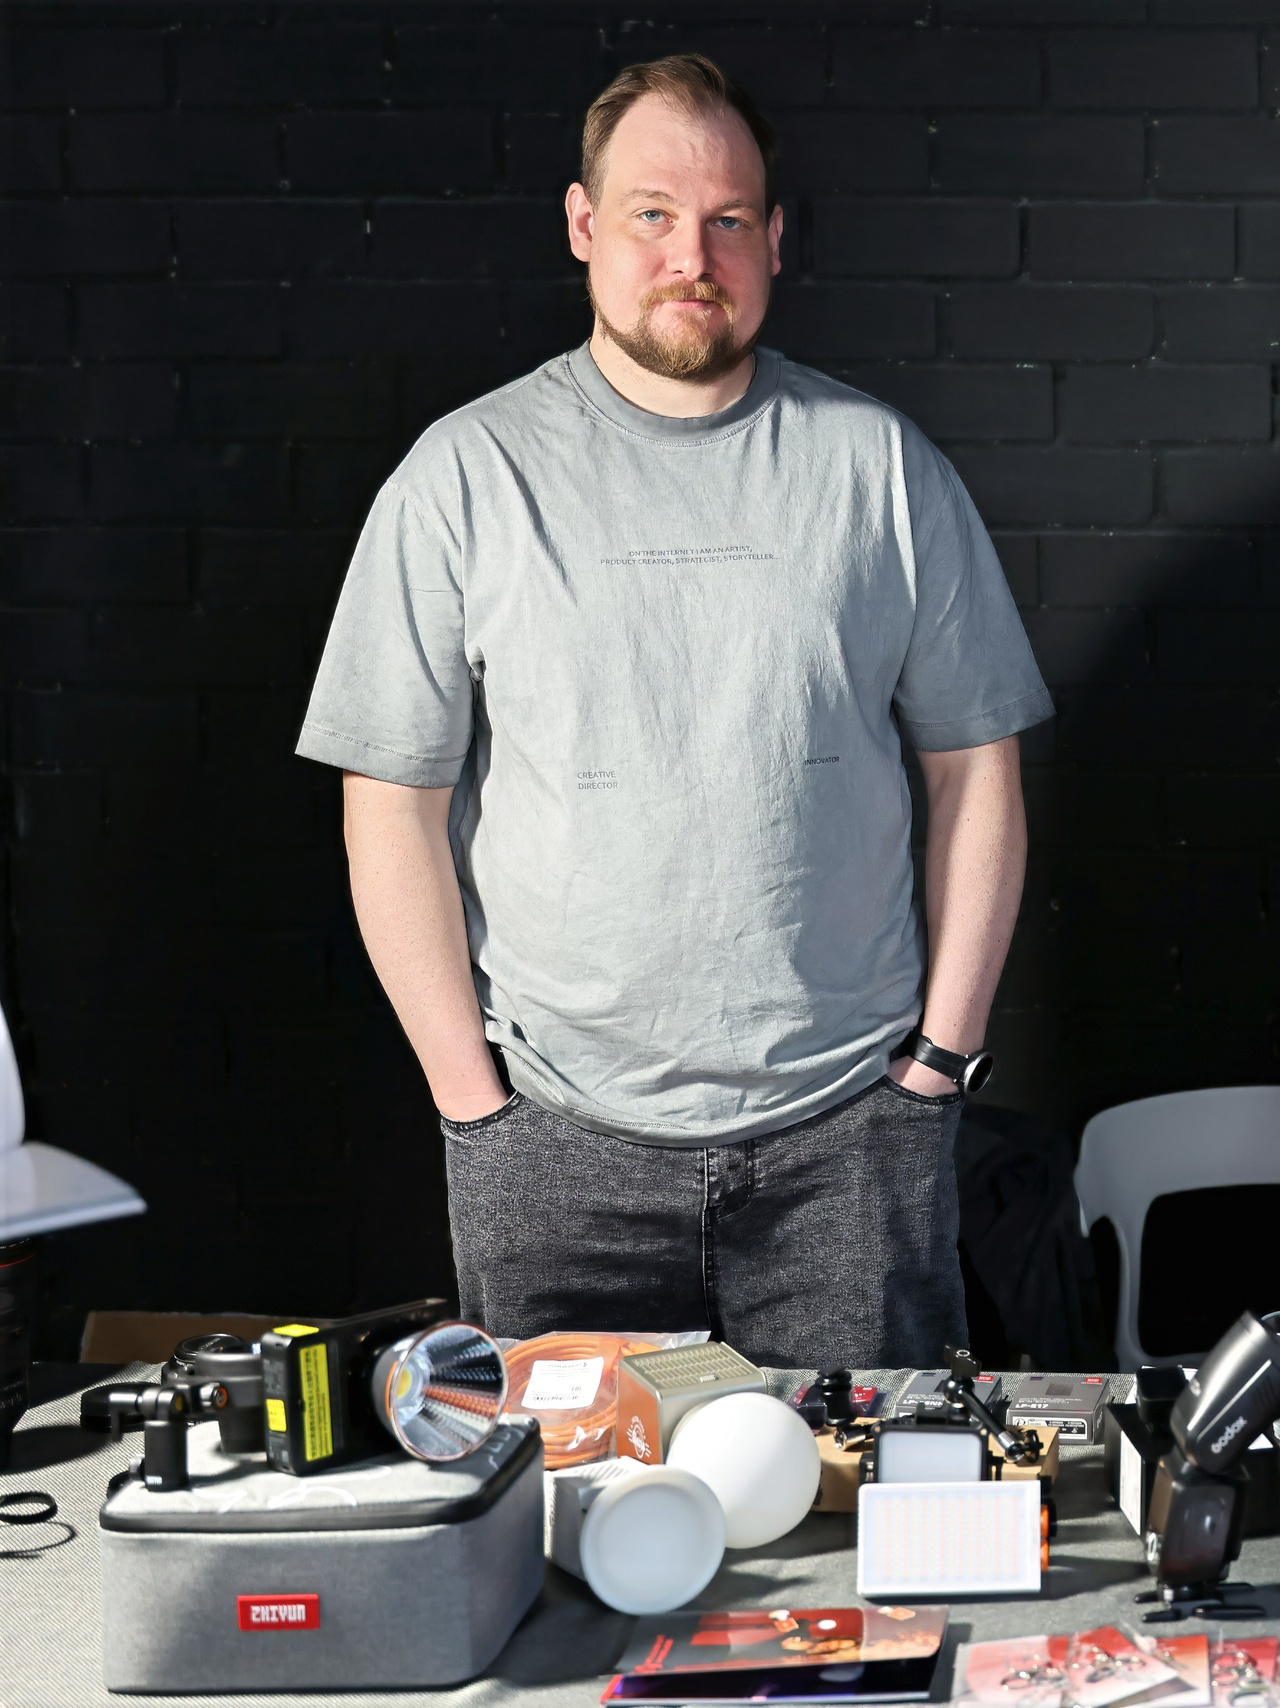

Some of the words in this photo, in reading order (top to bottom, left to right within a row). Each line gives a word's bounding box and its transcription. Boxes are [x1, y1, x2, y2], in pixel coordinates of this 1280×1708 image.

[657, 548, 695, 556] INTERNET
[725, 545, 753, 553] ARTIST,
[637, 558, 675, 566] CREATOR,
[675, 556, 723, 565] STRATEGIST,
[803, 755, 840, 766] INNOVATOR
[577, 770, 617, 779] CREATIVE
[578, 781, 619, 790] DIRECTOR
[250, 1604, 307, 1623] ZHIYUN
